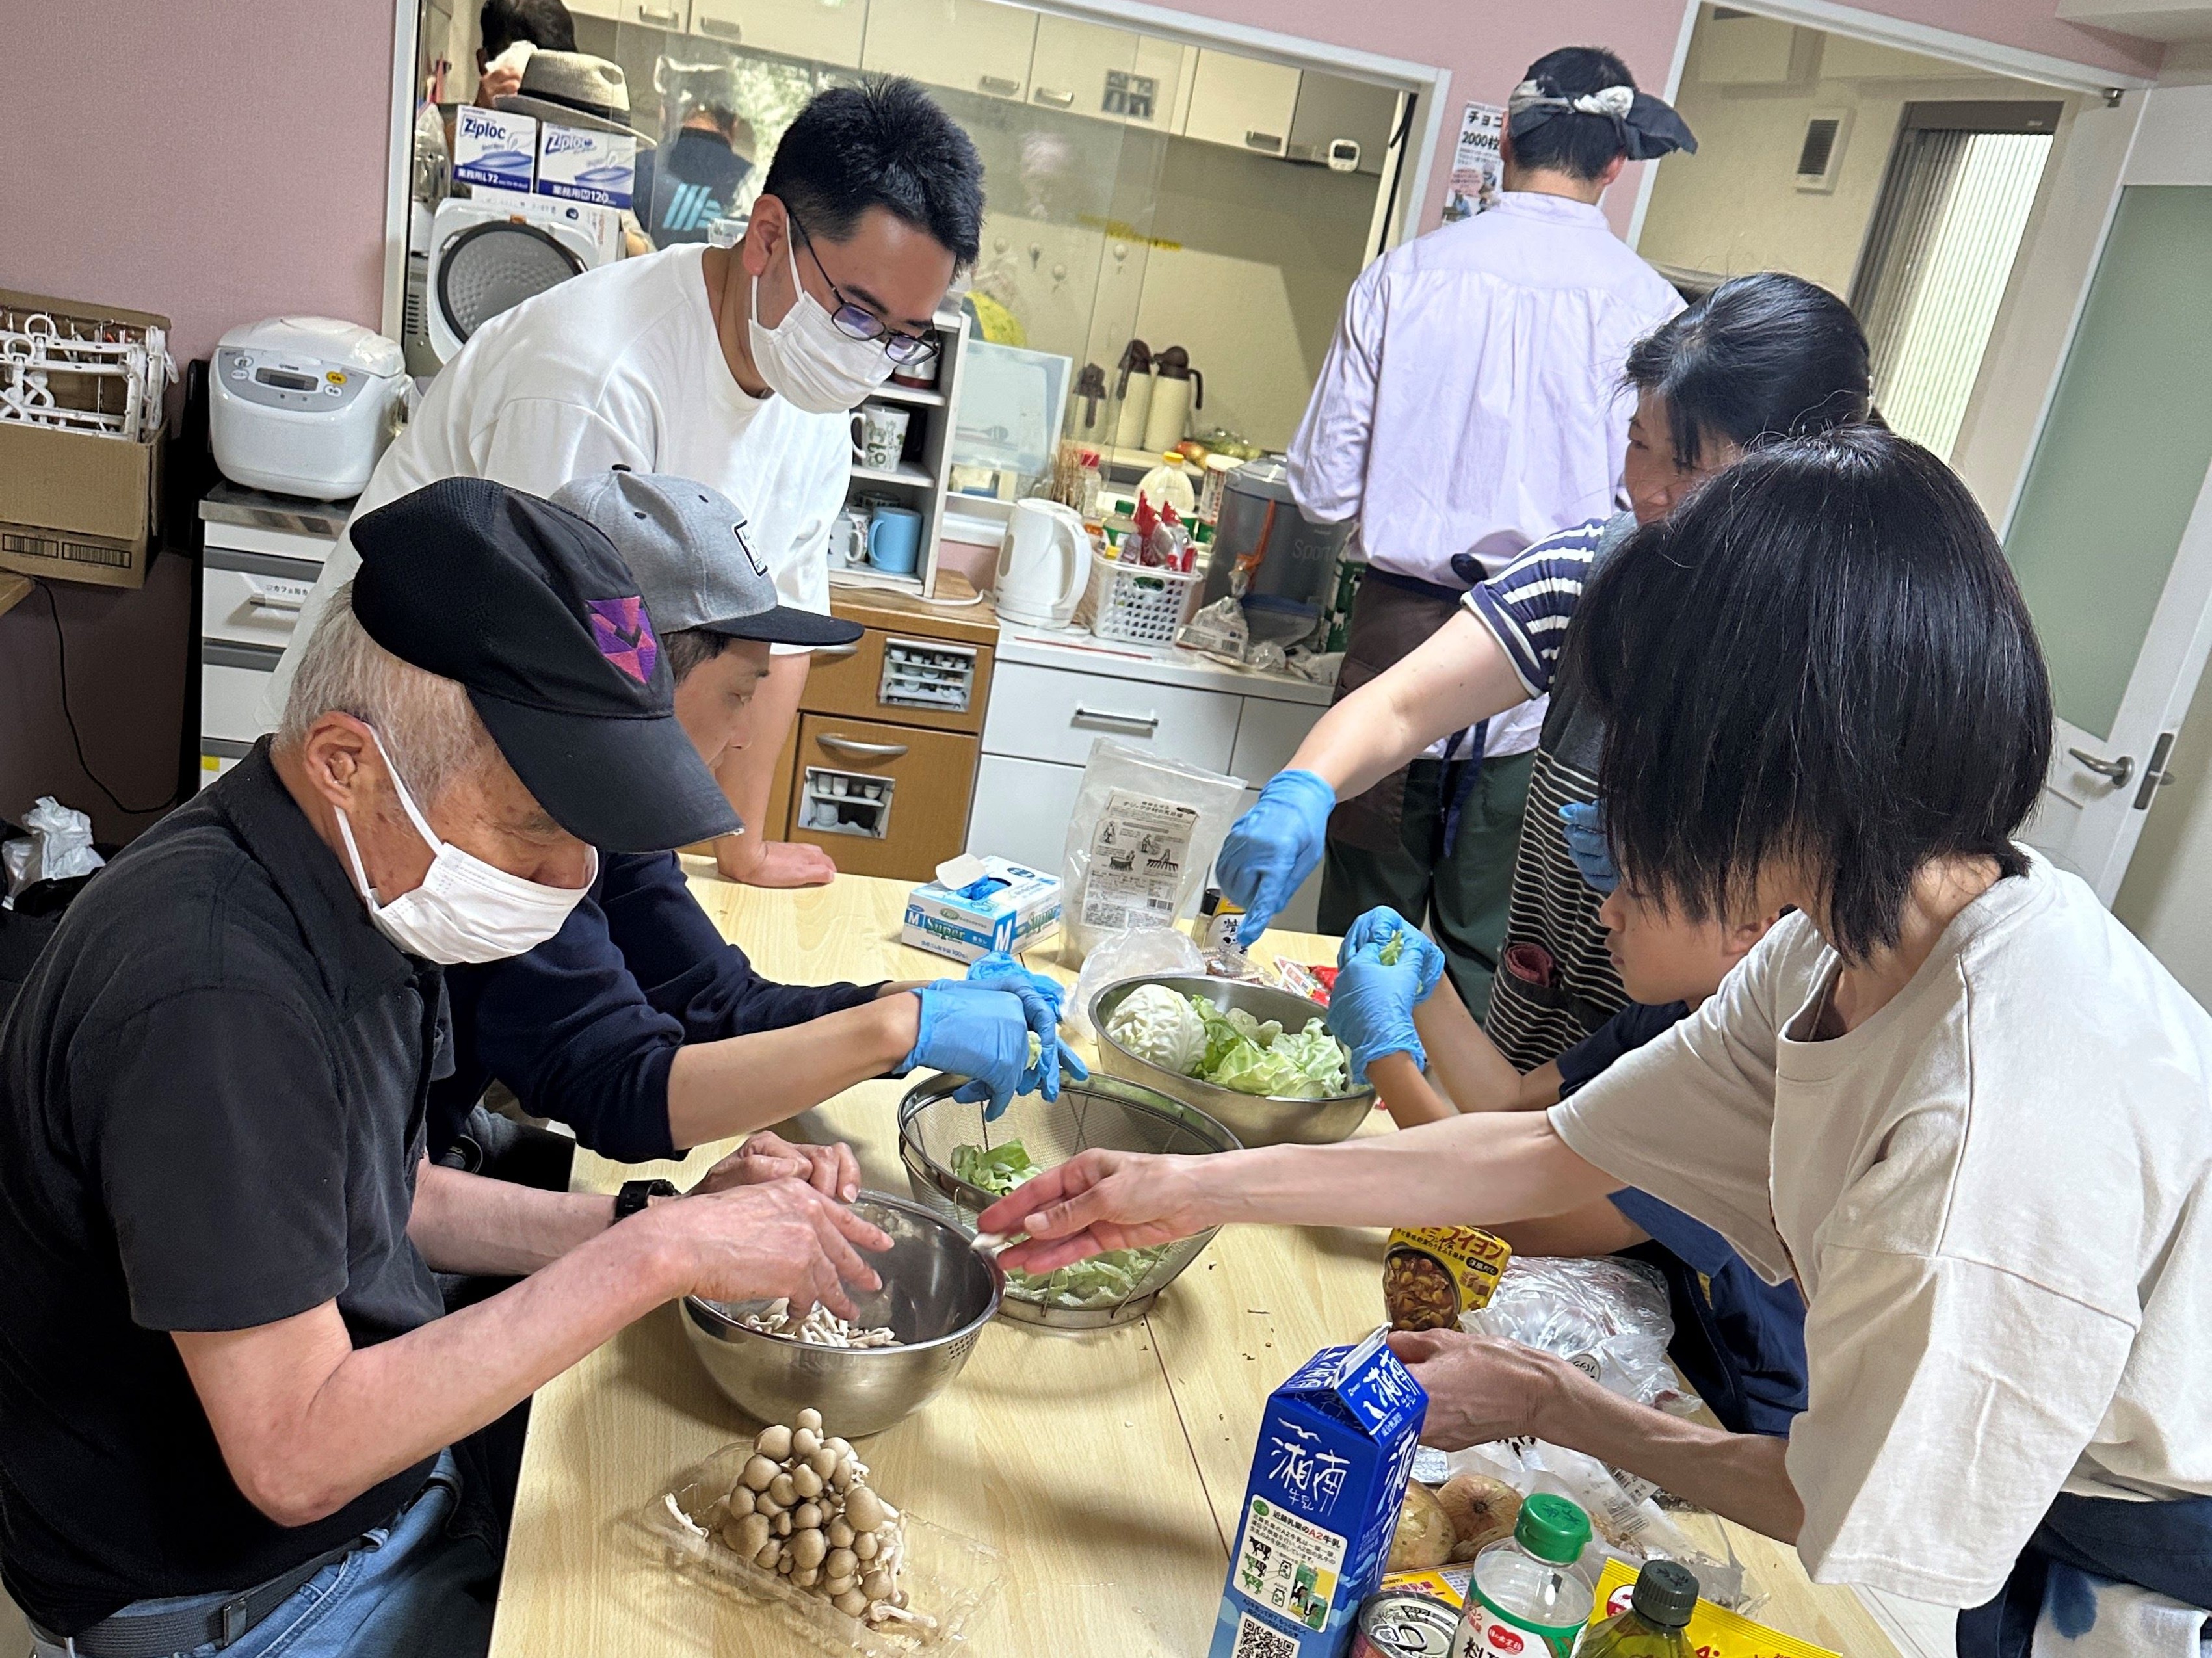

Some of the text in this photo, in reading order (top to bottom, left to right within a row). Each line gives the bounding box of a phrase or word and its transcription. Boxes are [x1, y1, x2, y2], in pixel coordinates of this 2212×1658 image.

[464, 118, 507, 139] Ziploc
[546, 133, 594, 154] Ziploc
[908, 911, 919, 926] M
[927, 916, 966, 940] Super
[994, 918, 1014, 952] M
[1268, 1436, 1350, 1516] 湘南
[1288, 1488, 1315, 1511] 牛乳
[1272, 1510, 1341, 1549] 近藤乳業のA2牛乳
